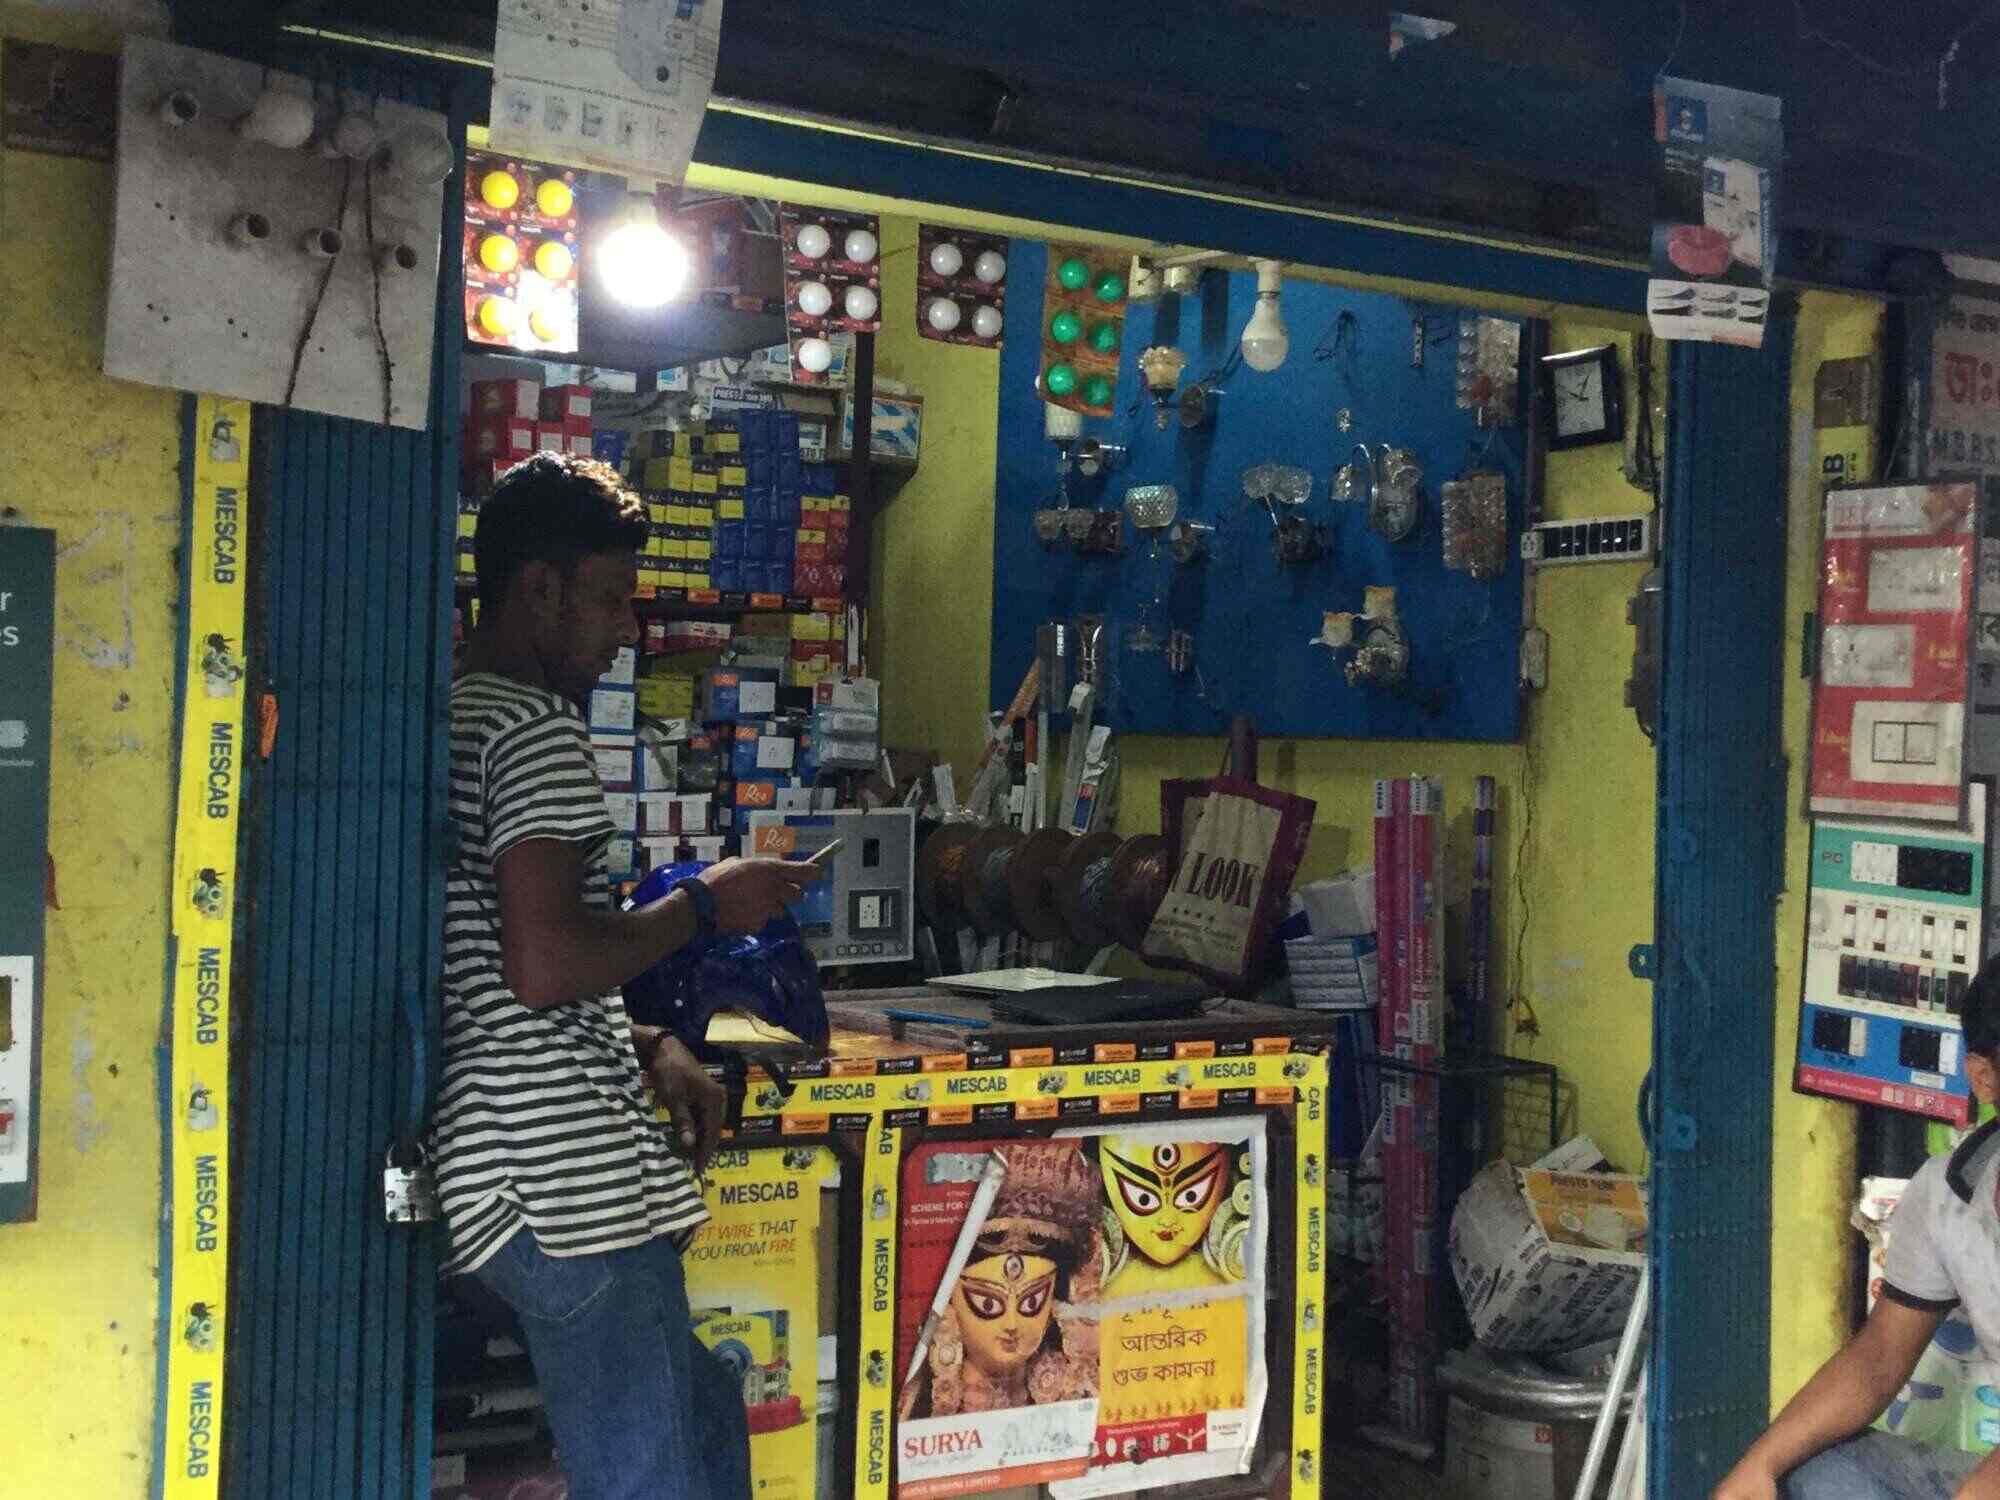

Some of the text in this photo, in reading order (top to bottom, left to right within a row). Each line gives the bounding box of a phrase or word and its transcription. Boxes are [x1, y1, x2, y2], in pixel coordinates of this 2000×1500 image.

[214, 487, 242, 585] MESCAB
[207, 722, 234, 820] MESCAB
[1187, 852, 1259, 908] LOOK
[195, 947, 222, 1045] MESCAB
[946, 1076, 1008, 1095] MESCAB
[1084, 1068, 1141, 1087] MESCAB
[1203, 1061, 1257, 1079] MESCAB
[810, 1083, 876, 1101] MESCAB
[194, 1155, 218, 1252] MESCAB
[720, 1180, 799, 1205] MESCAB
[690, 1238, 797, 1260] YOU FROM FIRE
[717, 1223, 754, 1240] WIRE
[759, 1219, 798, 1235] THAT
[1306, 1206, 1320, 1273] MESCAB
[872, 1238, 889, 1313] MESCAB
[710, 1320, 751, 1336] MESCAB
[1153, 1358, 1217, 1381] কামনা
[1303, 1347, 1318, 1416] MESCAB
[187, 1381, 213, 1480] MESCAB
[866, 1409, 884, 1485] MESCAB
[903, 1429, 984, 1459] SURYA
